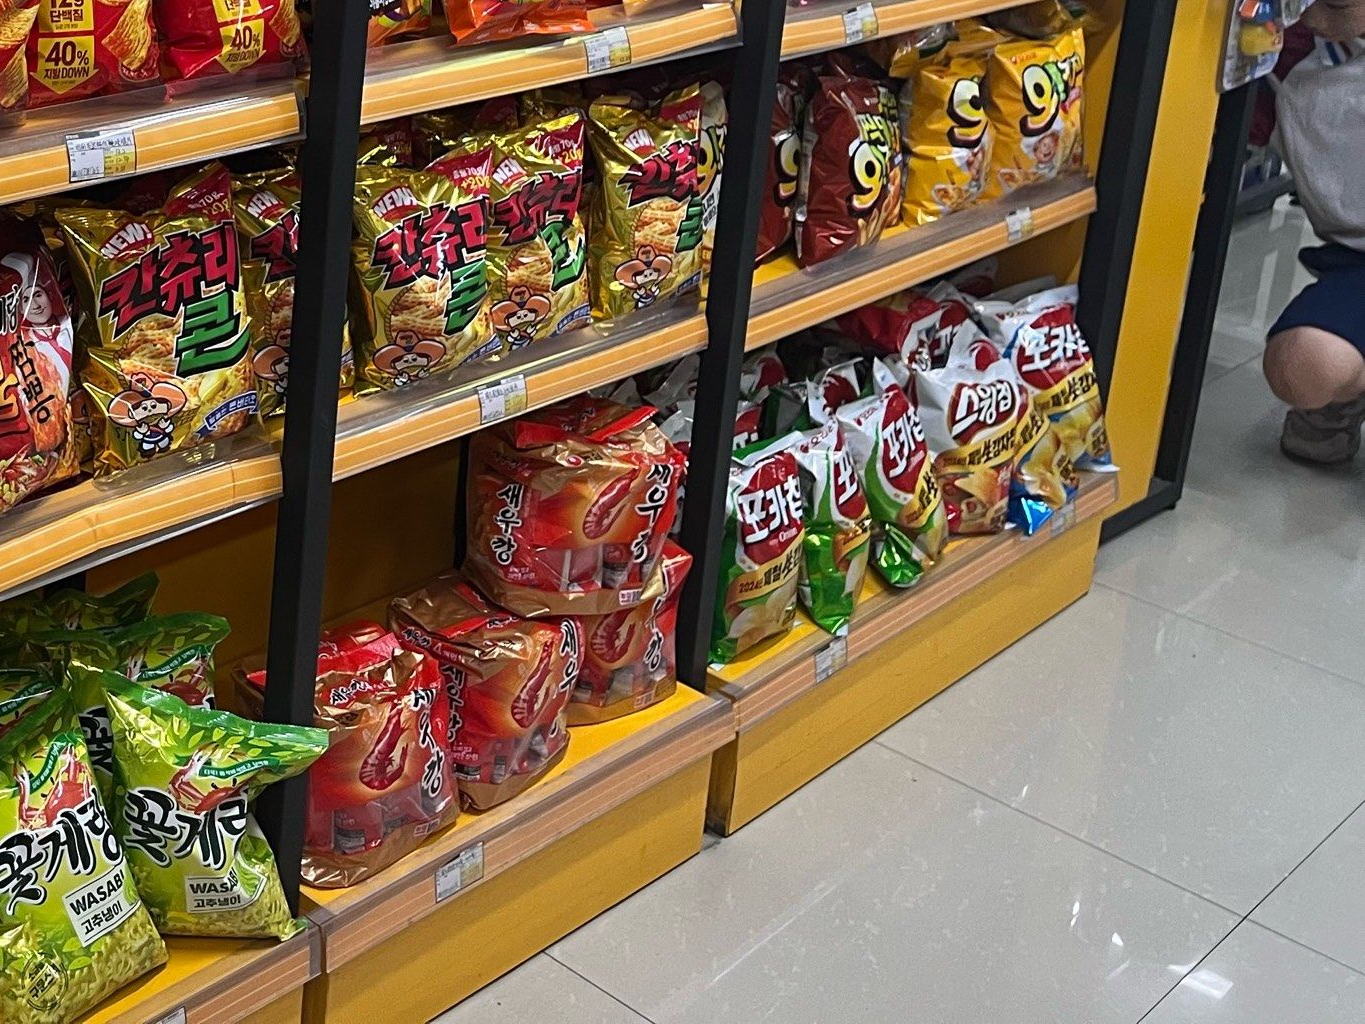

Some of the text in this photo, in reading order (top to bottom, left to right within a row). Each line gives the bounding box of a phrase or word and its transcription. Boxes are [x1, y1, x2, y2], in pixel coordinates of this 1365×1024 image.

[49, 8, 84, 23] 단백질
[44, 40, 90, 67] 40%
[233, 25, 262, 49] 40%
[373, 186, 418, 219] NEW!
[101, 222, 154, 259] NEW!
[950, 379, 1017, 439] 스윙칩
[490, 481, 524, 566] 새우깡
[69, 867, 125, 916] WASABI
[193, 896, 241, 910] 고추냉이
[80, 901, 124, 936] 고추냉이
